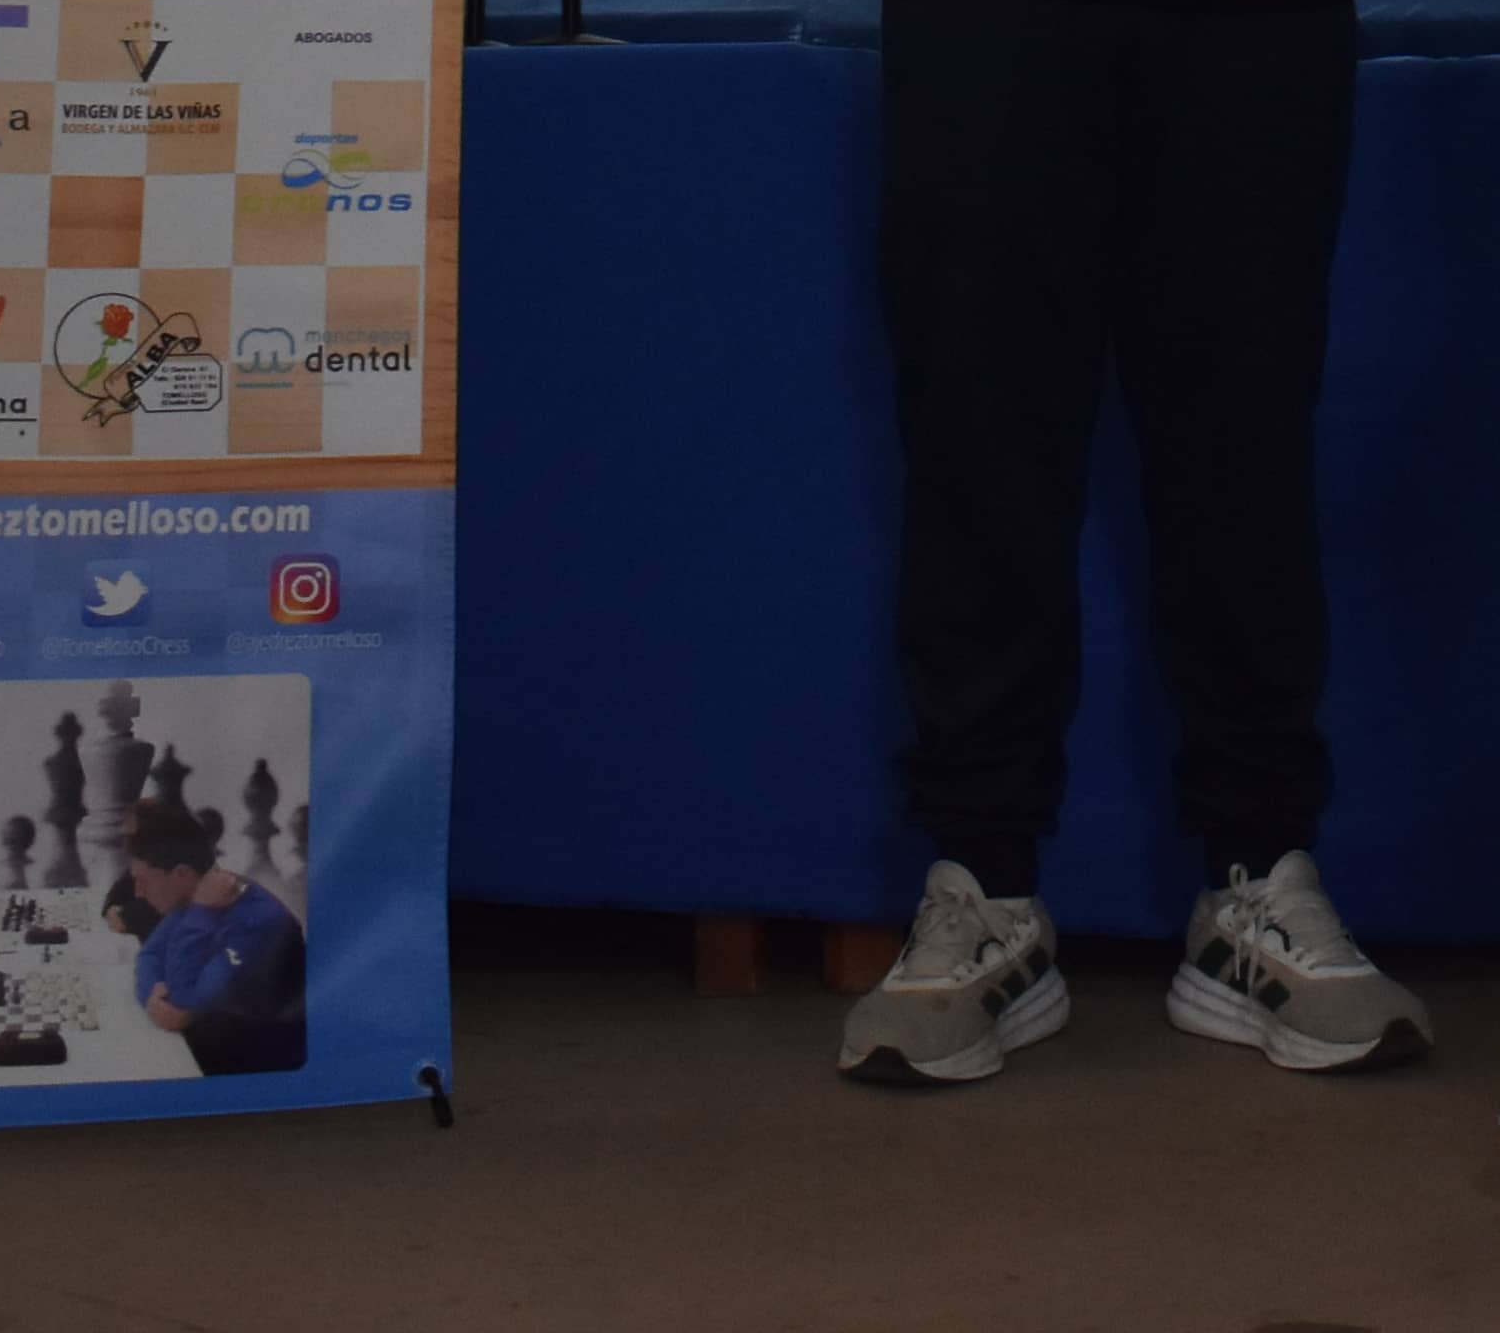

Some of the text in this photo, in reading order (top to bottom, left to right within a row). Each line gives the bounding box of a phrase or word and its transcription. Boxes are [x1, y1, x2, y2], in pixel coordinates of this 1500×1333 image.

[294, 31, 373, 44] ABOGADOS
[120, 38, 173, 83] V
[62, 101, 221, 120] VIRGEN DE LAS VIÑAS
[125, 332, 178, 390] ALBA
[305, 344, 412, 374] dental
